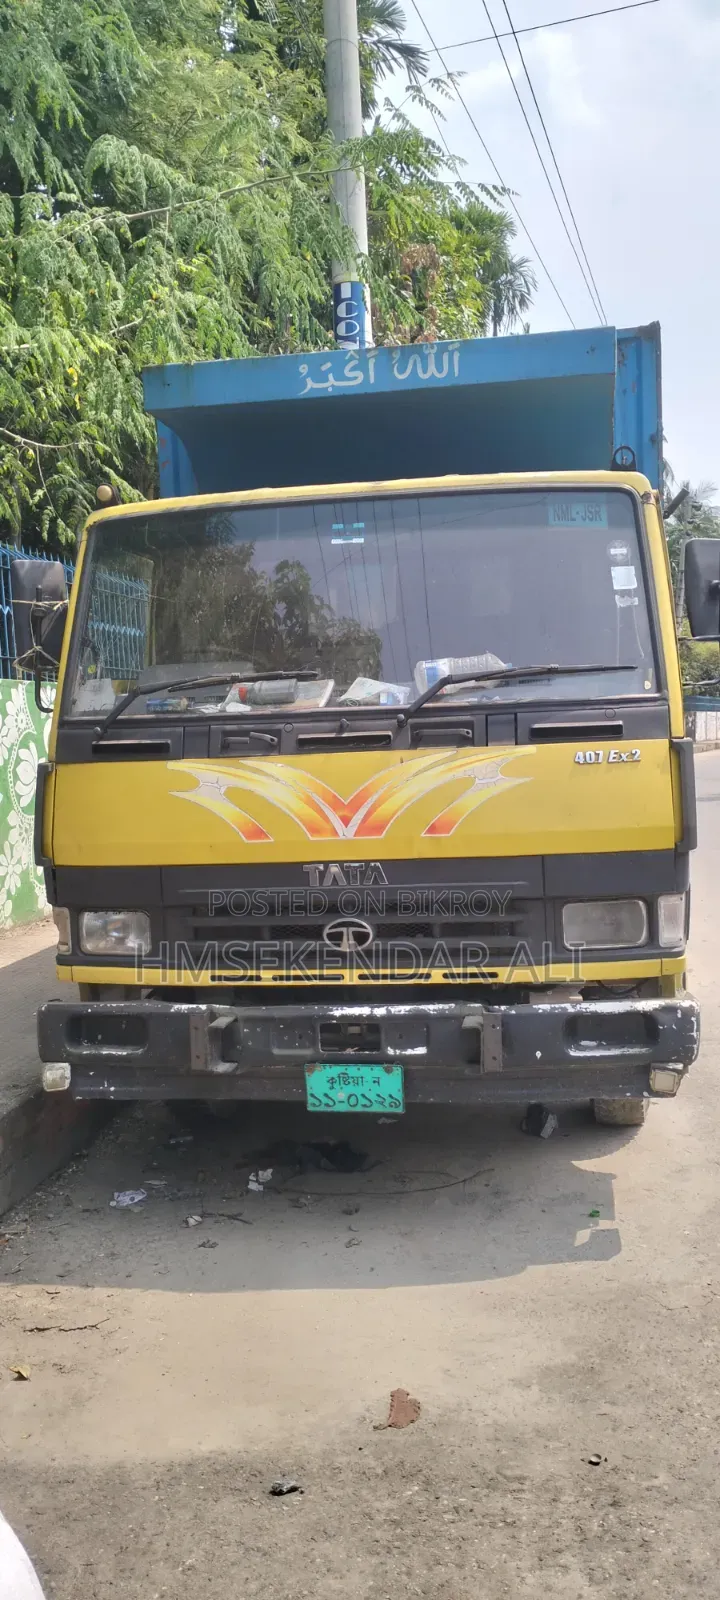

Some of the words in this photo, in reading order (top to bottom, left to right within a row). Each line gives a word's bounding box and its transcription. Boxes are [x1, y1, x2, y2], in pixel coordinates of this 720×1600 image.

[575, 750, 604, 764] 407
[302, 862, 389, 887] TATA
[309, 1093, 402, 1109] ১১-০১২৯
